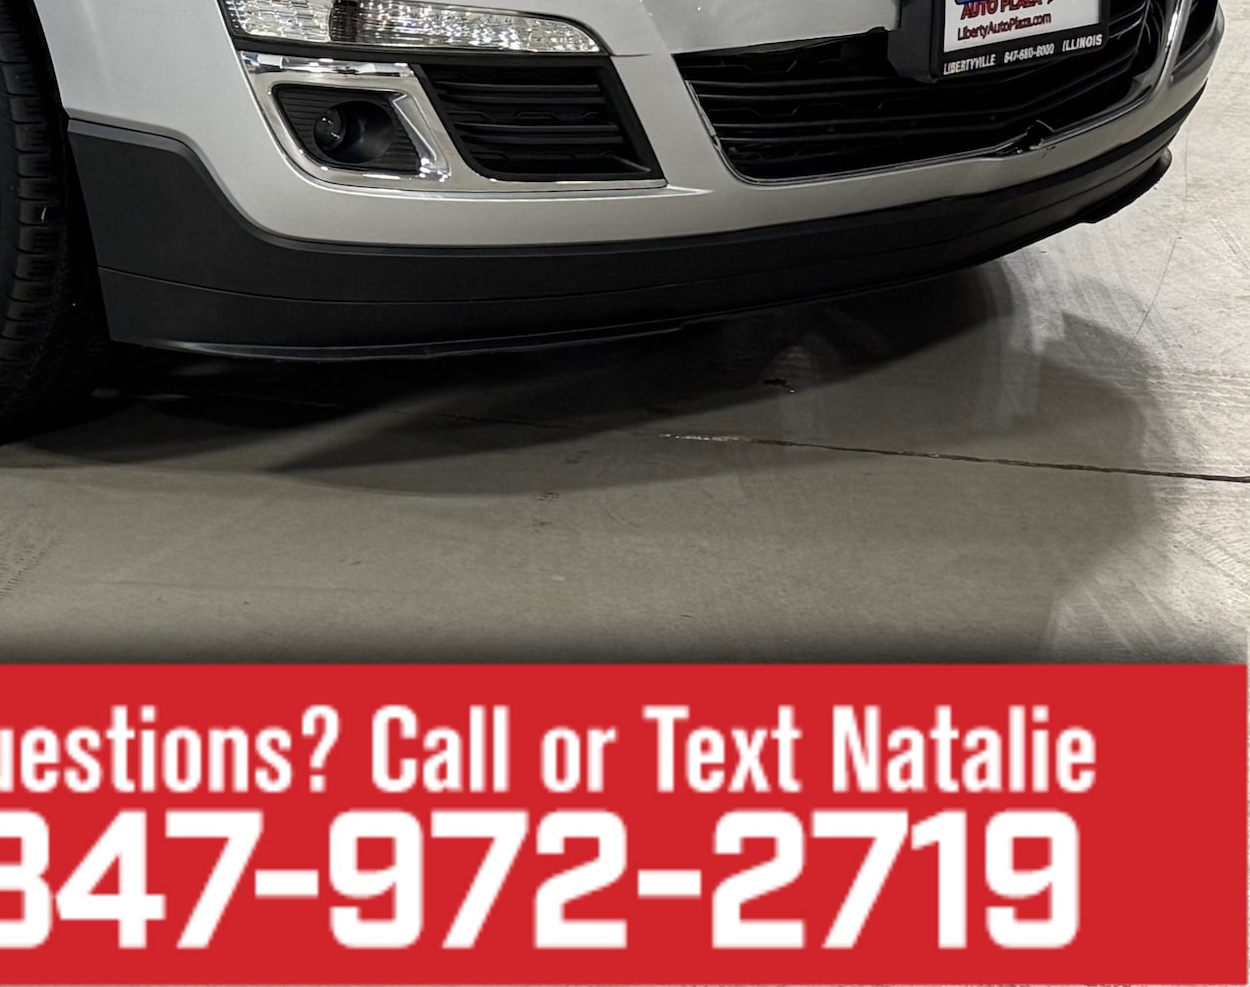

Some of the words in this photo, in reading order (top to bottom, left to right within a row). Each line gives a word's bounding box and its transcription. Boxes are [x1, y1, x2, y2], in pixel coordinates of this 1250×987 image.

[957, 13, 1052, 41] LibertyAutoPlaza.com
[943, 54, 996, 75] LIBERTYVILLE
[1062, 34, 1102, 52] ILLINOIS
